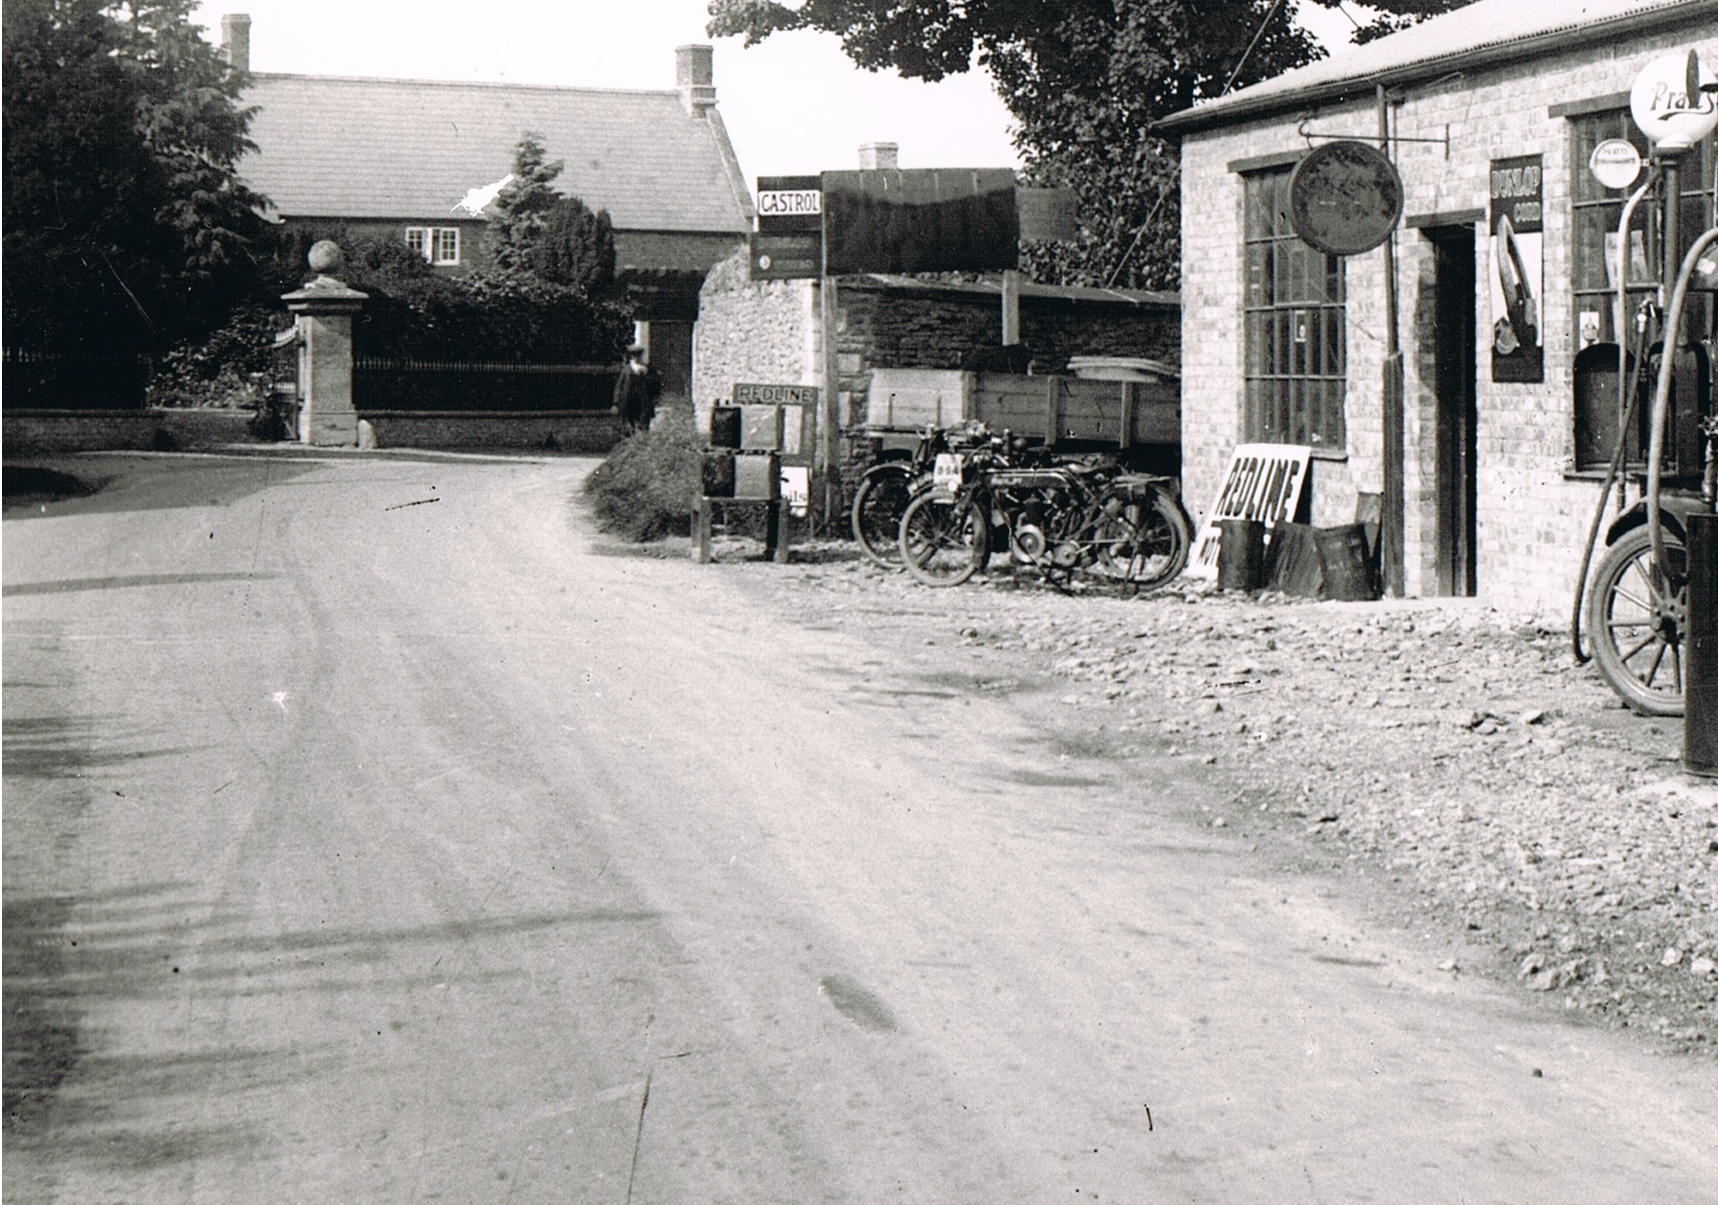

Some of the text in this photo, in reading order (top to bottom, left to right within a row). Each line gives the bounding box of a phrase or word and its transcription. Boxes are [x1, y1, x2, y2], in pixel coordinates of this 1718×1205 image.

[1490, 165, 1541, 199] DUNLOP
[761, 193, 819, 213] CASTROL
[738, 386, 812, 403] REDLINE
[1214, 456, 1302, 522] REDLINE
